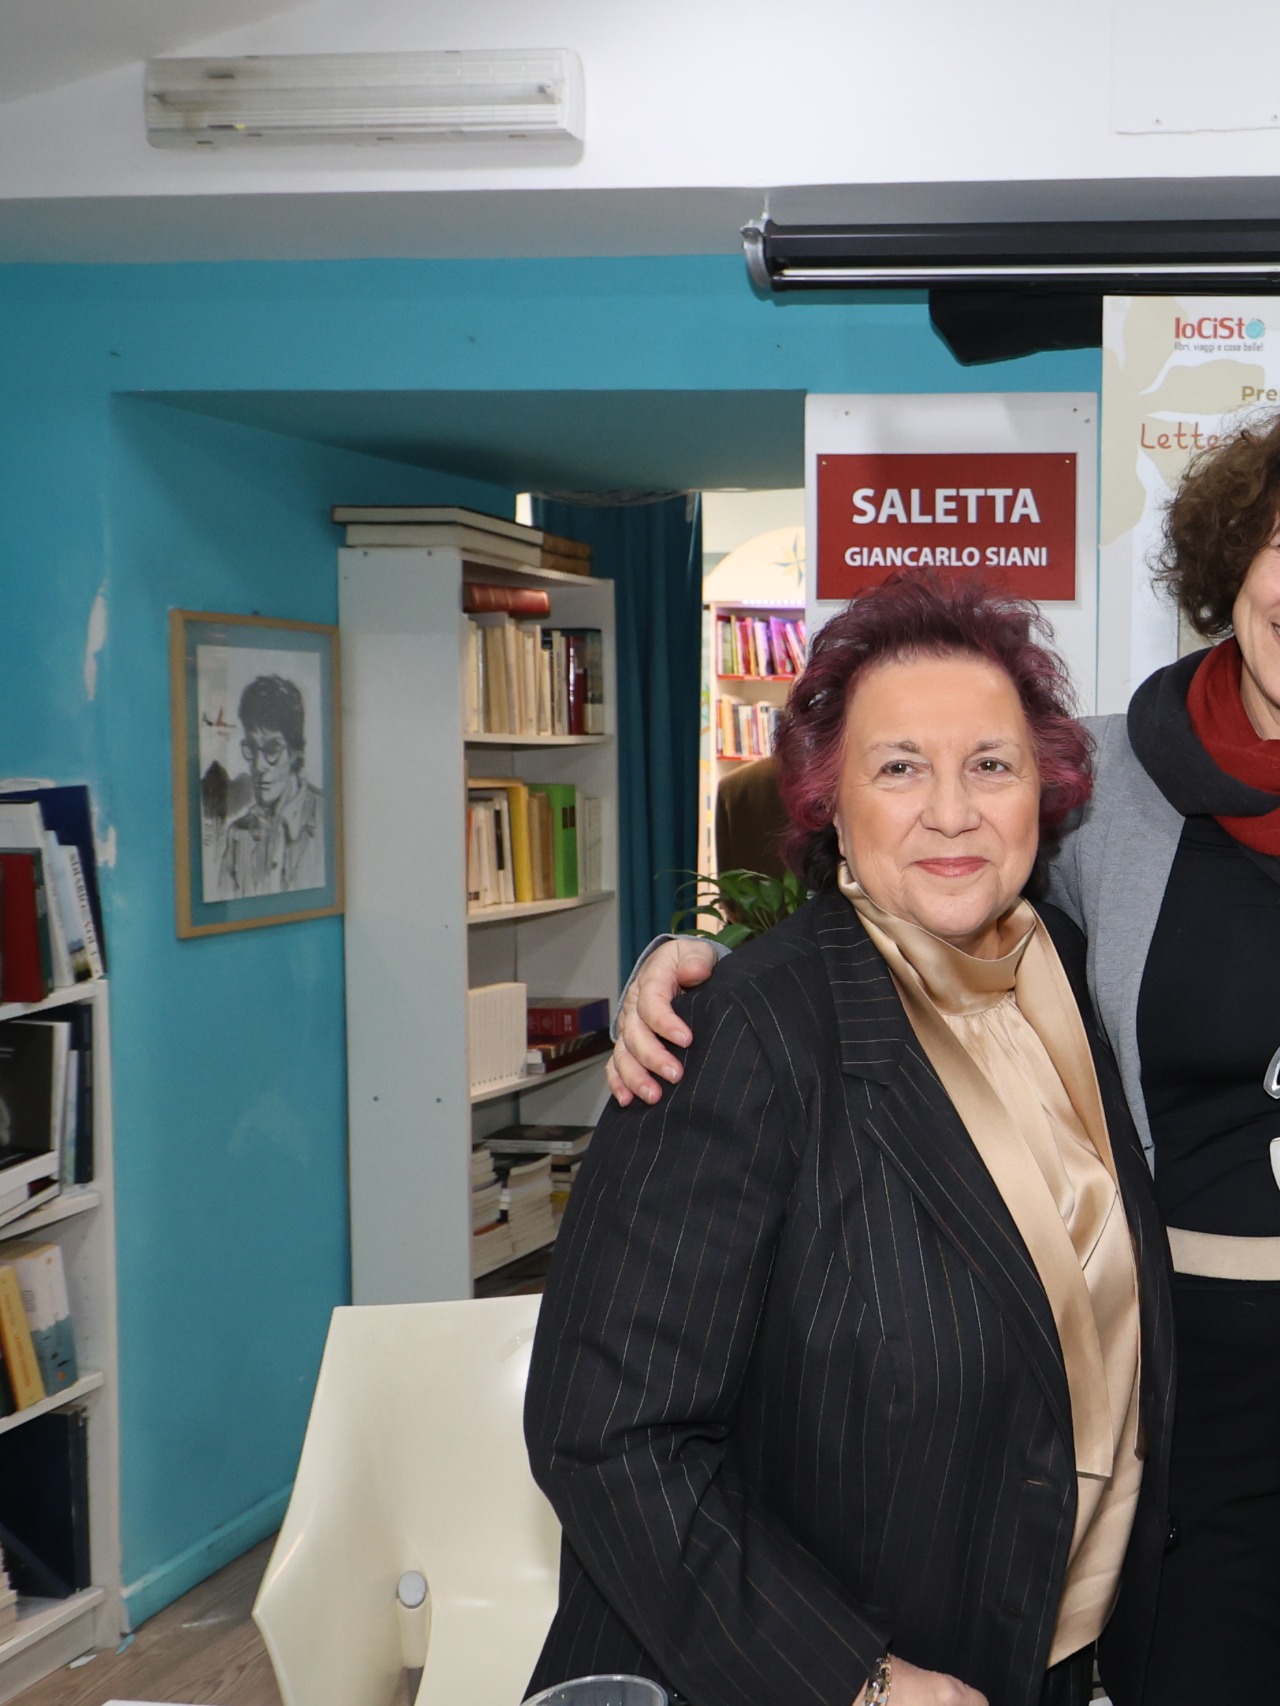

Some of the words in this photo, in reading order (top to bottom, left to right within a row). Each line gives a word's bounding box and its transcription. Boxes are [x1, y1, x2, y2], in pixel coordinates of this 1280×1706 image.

[1194, 342, 1215, 354] viaggi
[851, 487, 1041, 525] SALETTA
[844, 546, 981, 568] GIANCARLO
[985, 546, 1048, 567] SIANI
